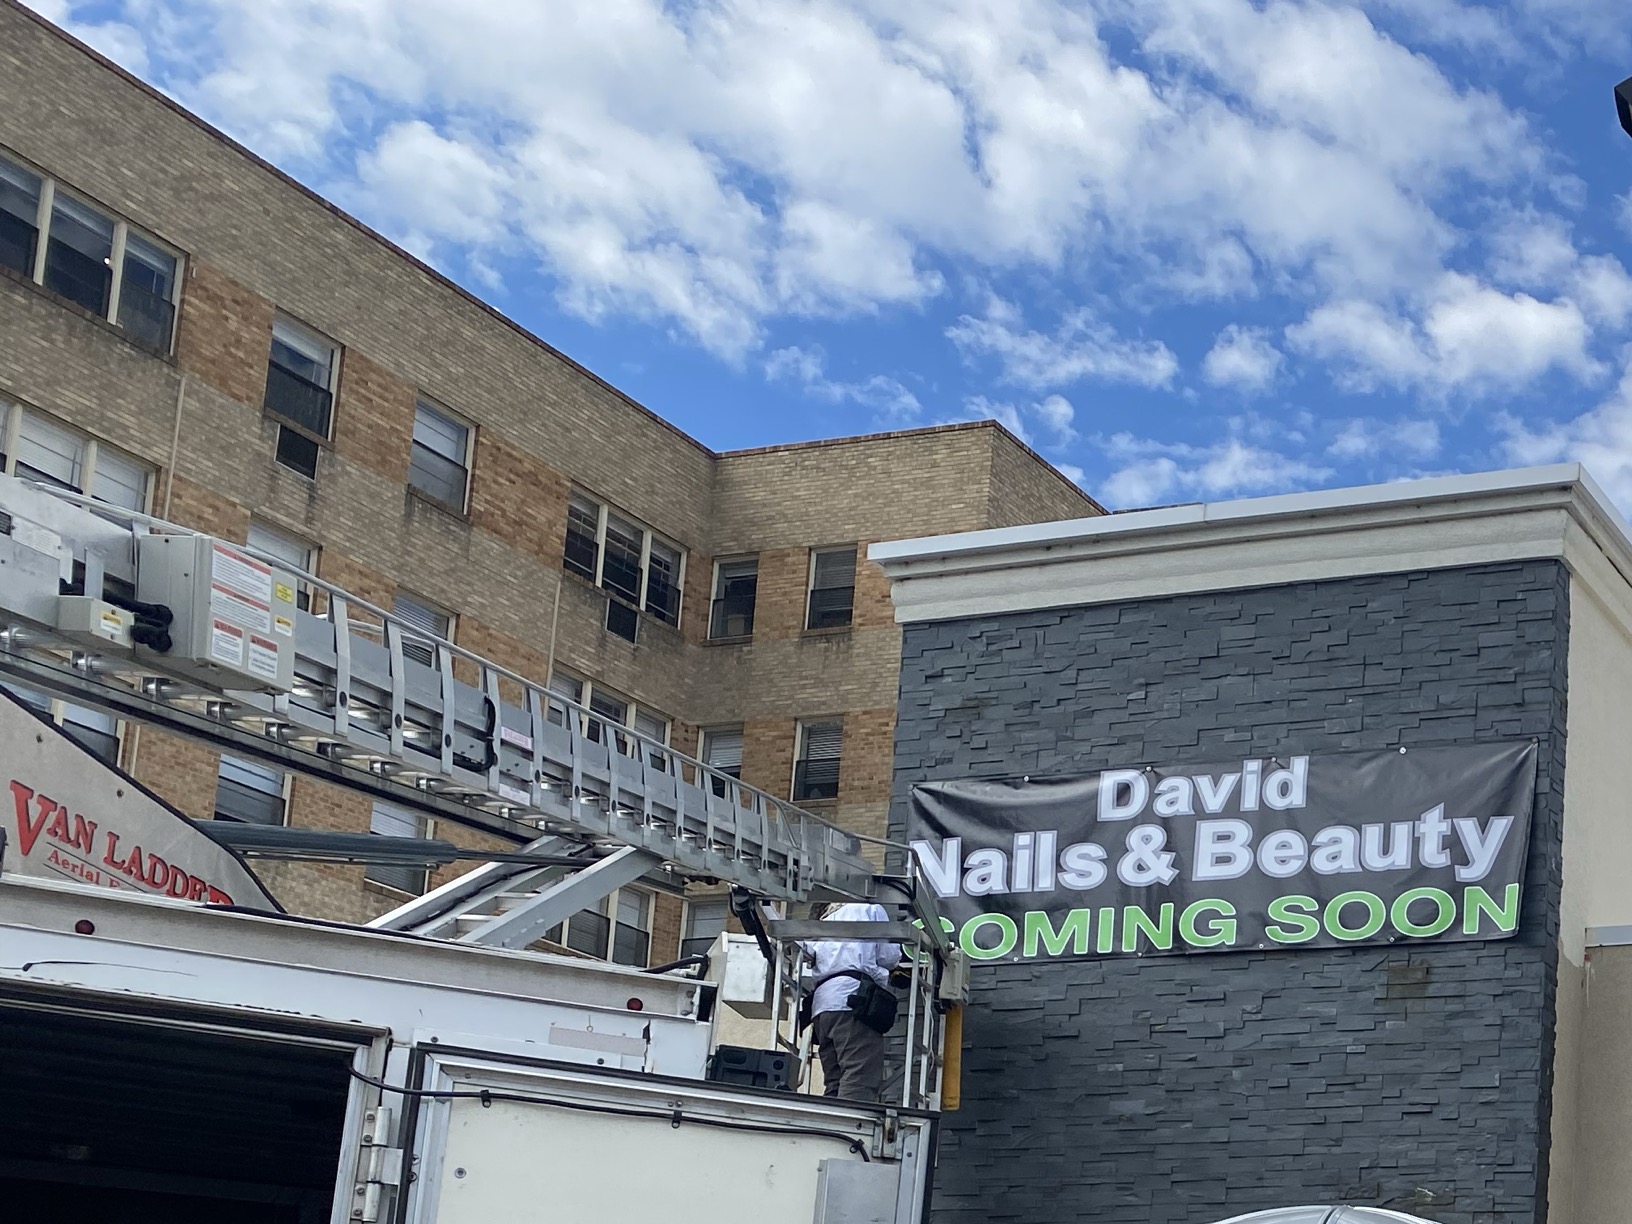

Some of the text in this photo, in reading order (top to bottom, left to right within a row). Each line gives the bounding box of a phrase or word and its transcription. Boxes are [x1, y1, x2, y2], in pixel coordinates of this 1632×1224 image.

[10, 779, 98, 857] VAN
[1097, 755, 1309, 822] David
[47, 849, 101, 886] Aerial
[908, 802, 1515, 898] Nails & Beauty
[1266, 882, 1521, 944] SOON
